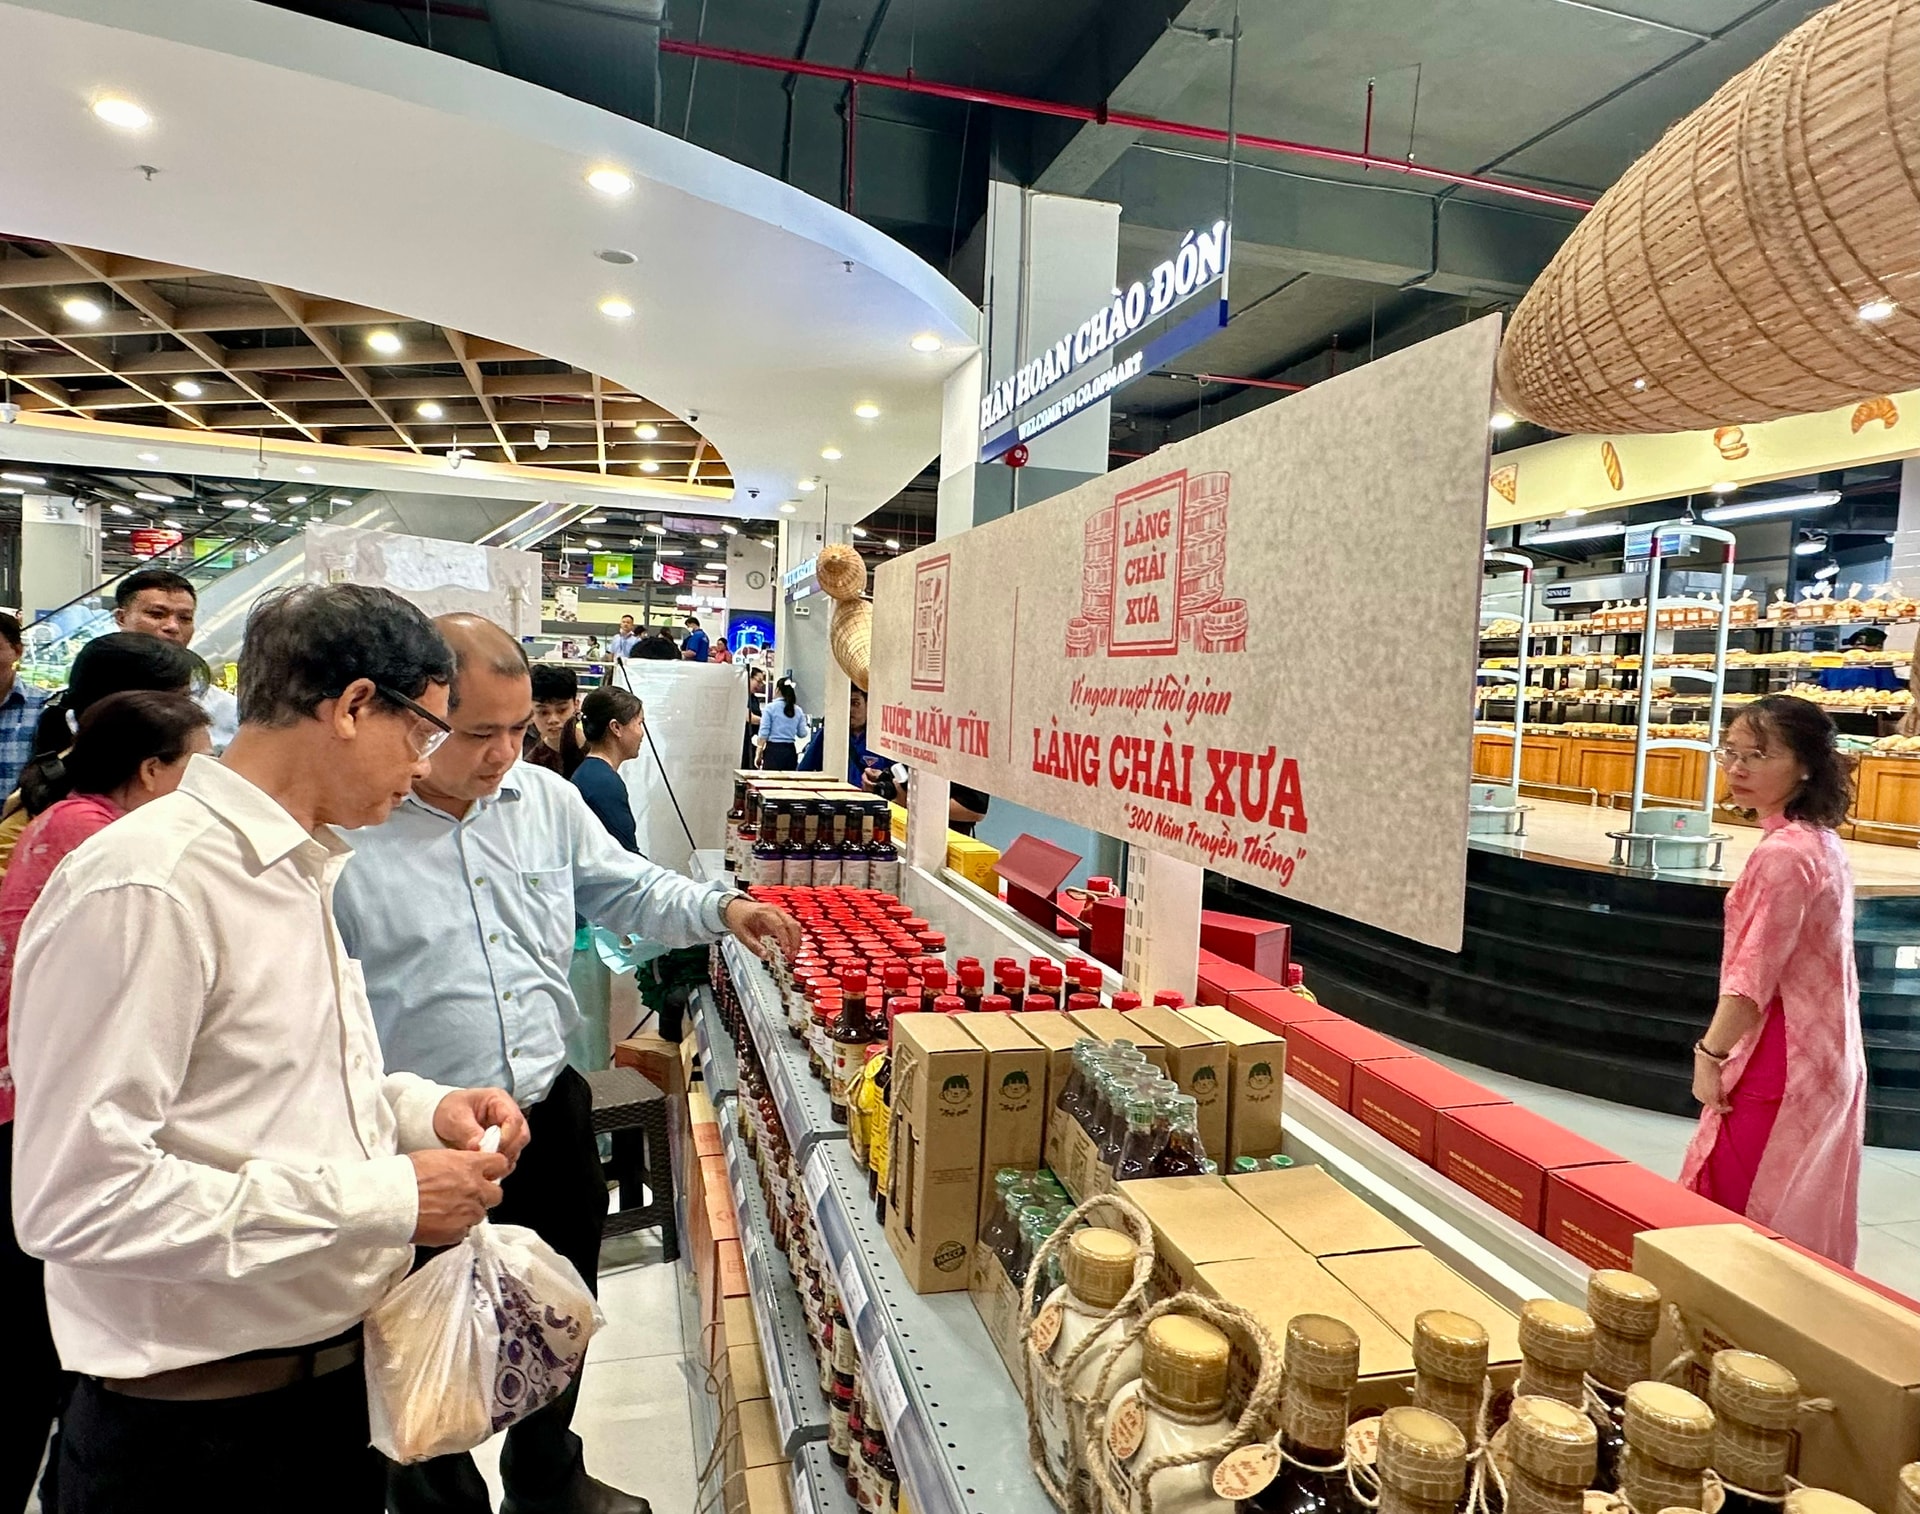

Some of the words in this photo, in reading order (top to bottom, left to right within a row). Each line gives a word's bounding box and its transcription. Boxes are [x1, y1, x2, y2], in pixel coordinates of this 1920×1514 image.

[980, 376, 1015, 431] HÂN
[1015, 333, 1073, 406] HOAN
[1074, 282, 1146, 364] CHÀO
[1151, 220, 1226, 315] ĐÓN
[1018, 403, 1062, 441] WELCOME
[1061, 393, 1076, 417] TO
[1123, 508, 1171, 548] LÀNG
[1124, 543, 1167, 587] CHÀI
[1125, 592, 1160, 625] XƯA
[1082, 685, 1118, 717] ngon
[1119, 677, 1153, 717] vượt
[1152, 672, 1190, 712] thời
[1185, 676, 1232, 726] gian
[880, 701, 913, 739] NƯỚC
[915, 705, 953, 749] MẮM
[957, 710, 990, 759] TĨN
[1032, 715, 1101, 788] LÀNG
[1108, 720, 1195, 806] CHÀI
[1204, 745, 1308, 834] XƯA
[1153, 812, 1184, 842] Năm
[1186, 819, 1239, 864] Truyền
